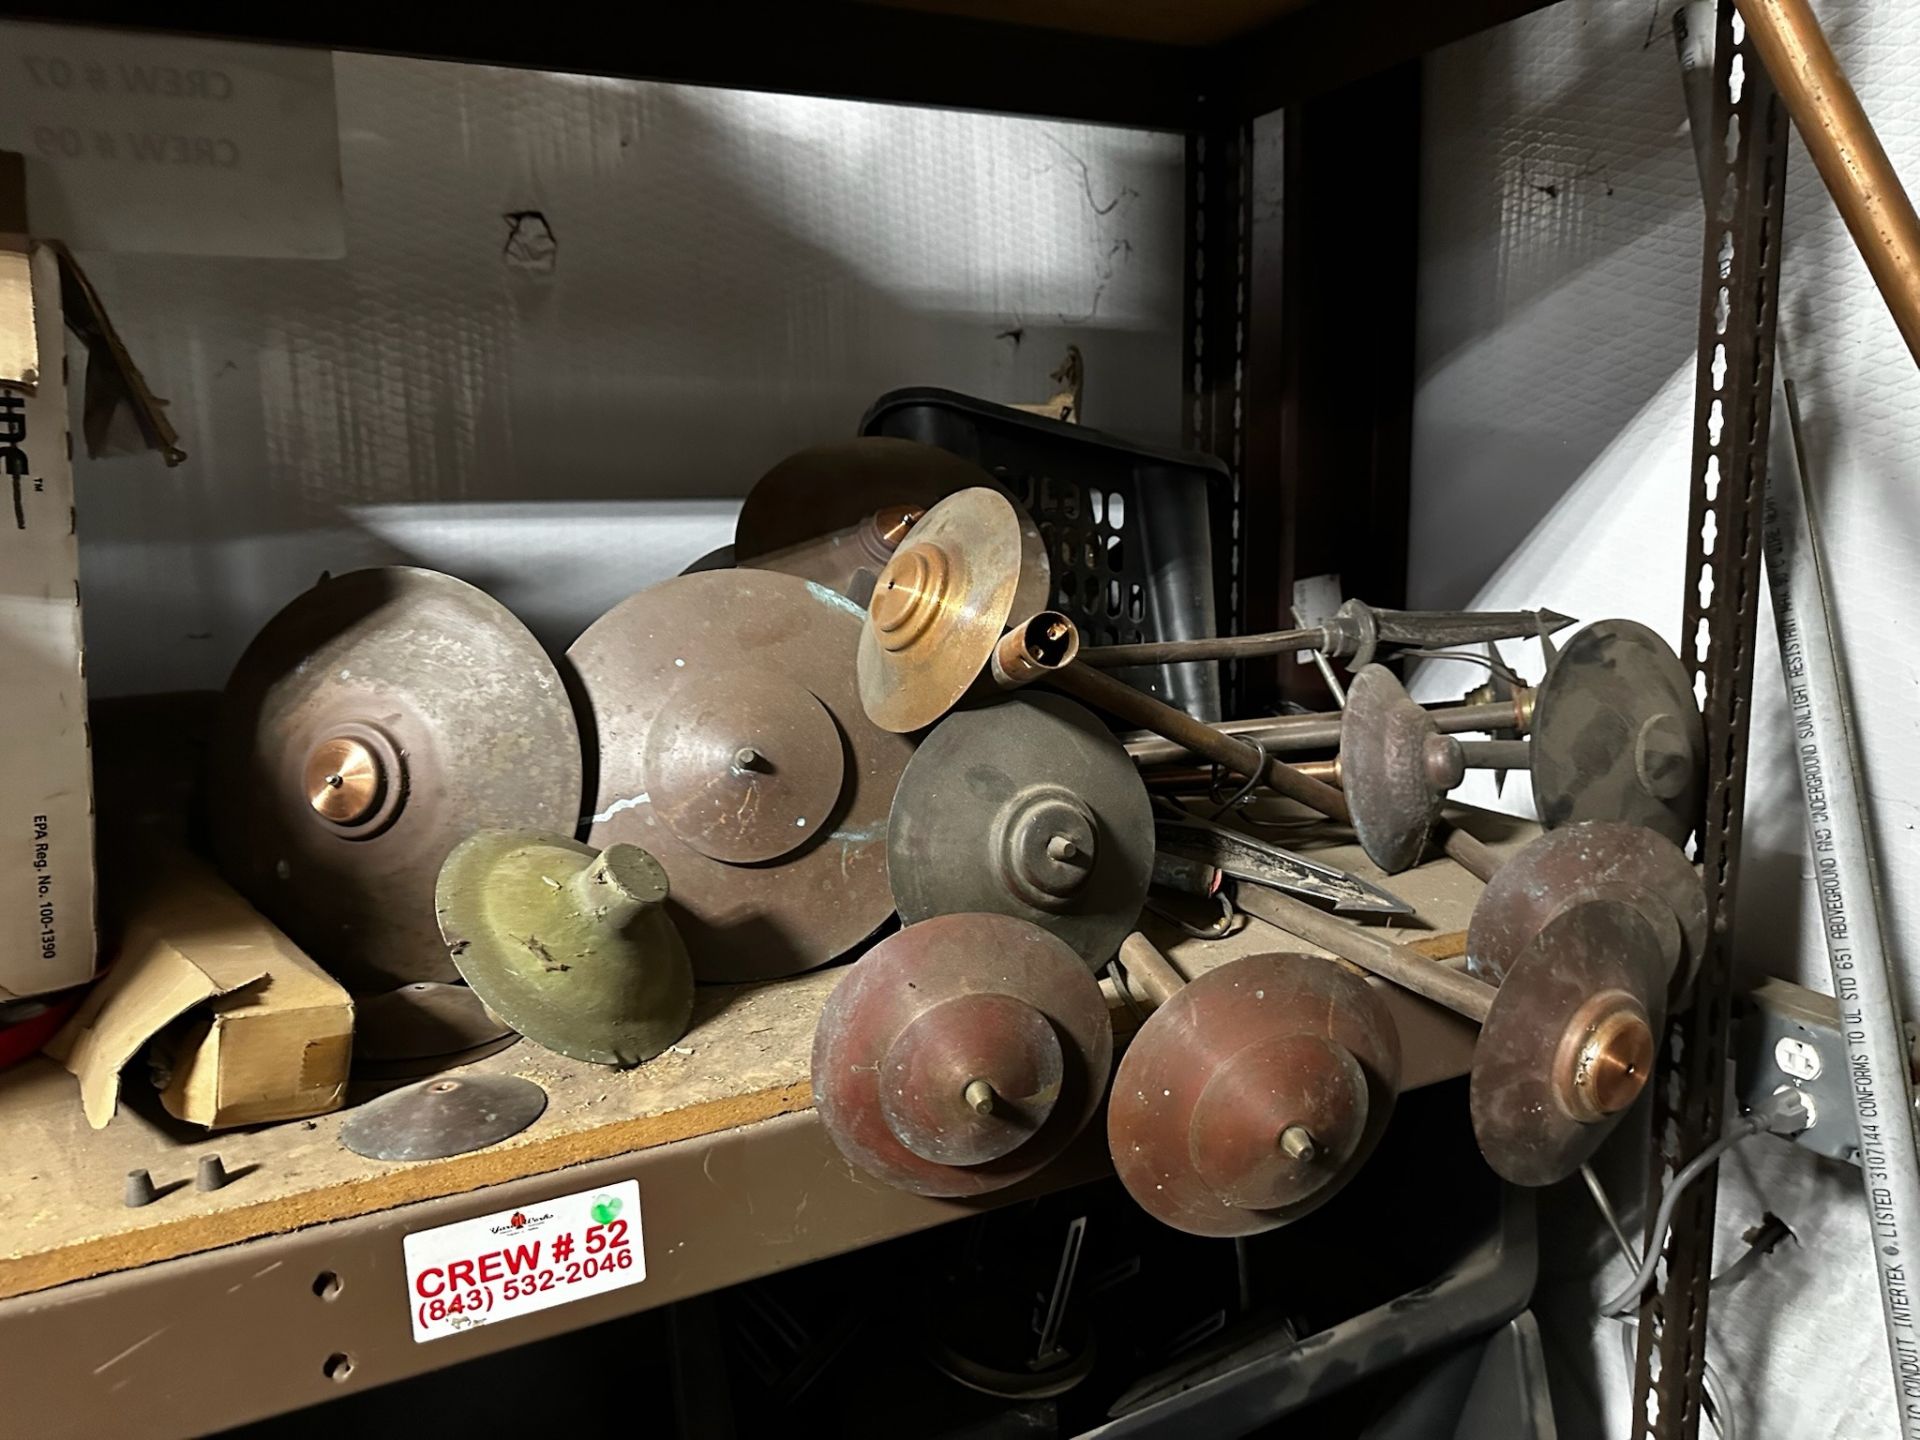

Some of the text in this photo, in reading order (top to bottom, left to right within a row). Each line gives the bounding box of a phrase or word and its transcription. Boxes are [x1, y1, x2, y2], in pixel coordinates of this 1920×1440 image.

[1779, 617, 1805, 679] RESISTANT
[1789, 683, 1815, 738] SUNLIGHT
[1801, 744, 1829, 823] UNDERGROUND
[1814, 828, 1834, 852] AND
[33, 815, 56, 959] EPA Reg. No. 100-1390
[1819, 857, 1849, 940] ABOVEGROUND
[1834, 947, 1853, 970] 651
[1839, 977, 1860, 1000] STD
[1843, 1008, 1862, 1024] UL
[1848, 1031, 1866, 1046] TO
[1851, 1055, 1877, 1118] CONFORMS
[1865, 1124, 1888, 1180] 3107144
[1872, 1188, 1897, 1239] LISTED
[416, 1219, 630, 1298] CREW # 52
[418, 1249, 633, 1329] (843) 532-2046
[1884, 1264, 1912, 1328] INTERTEK
[1896, 1336, 1920, 1398] CONDUIT
